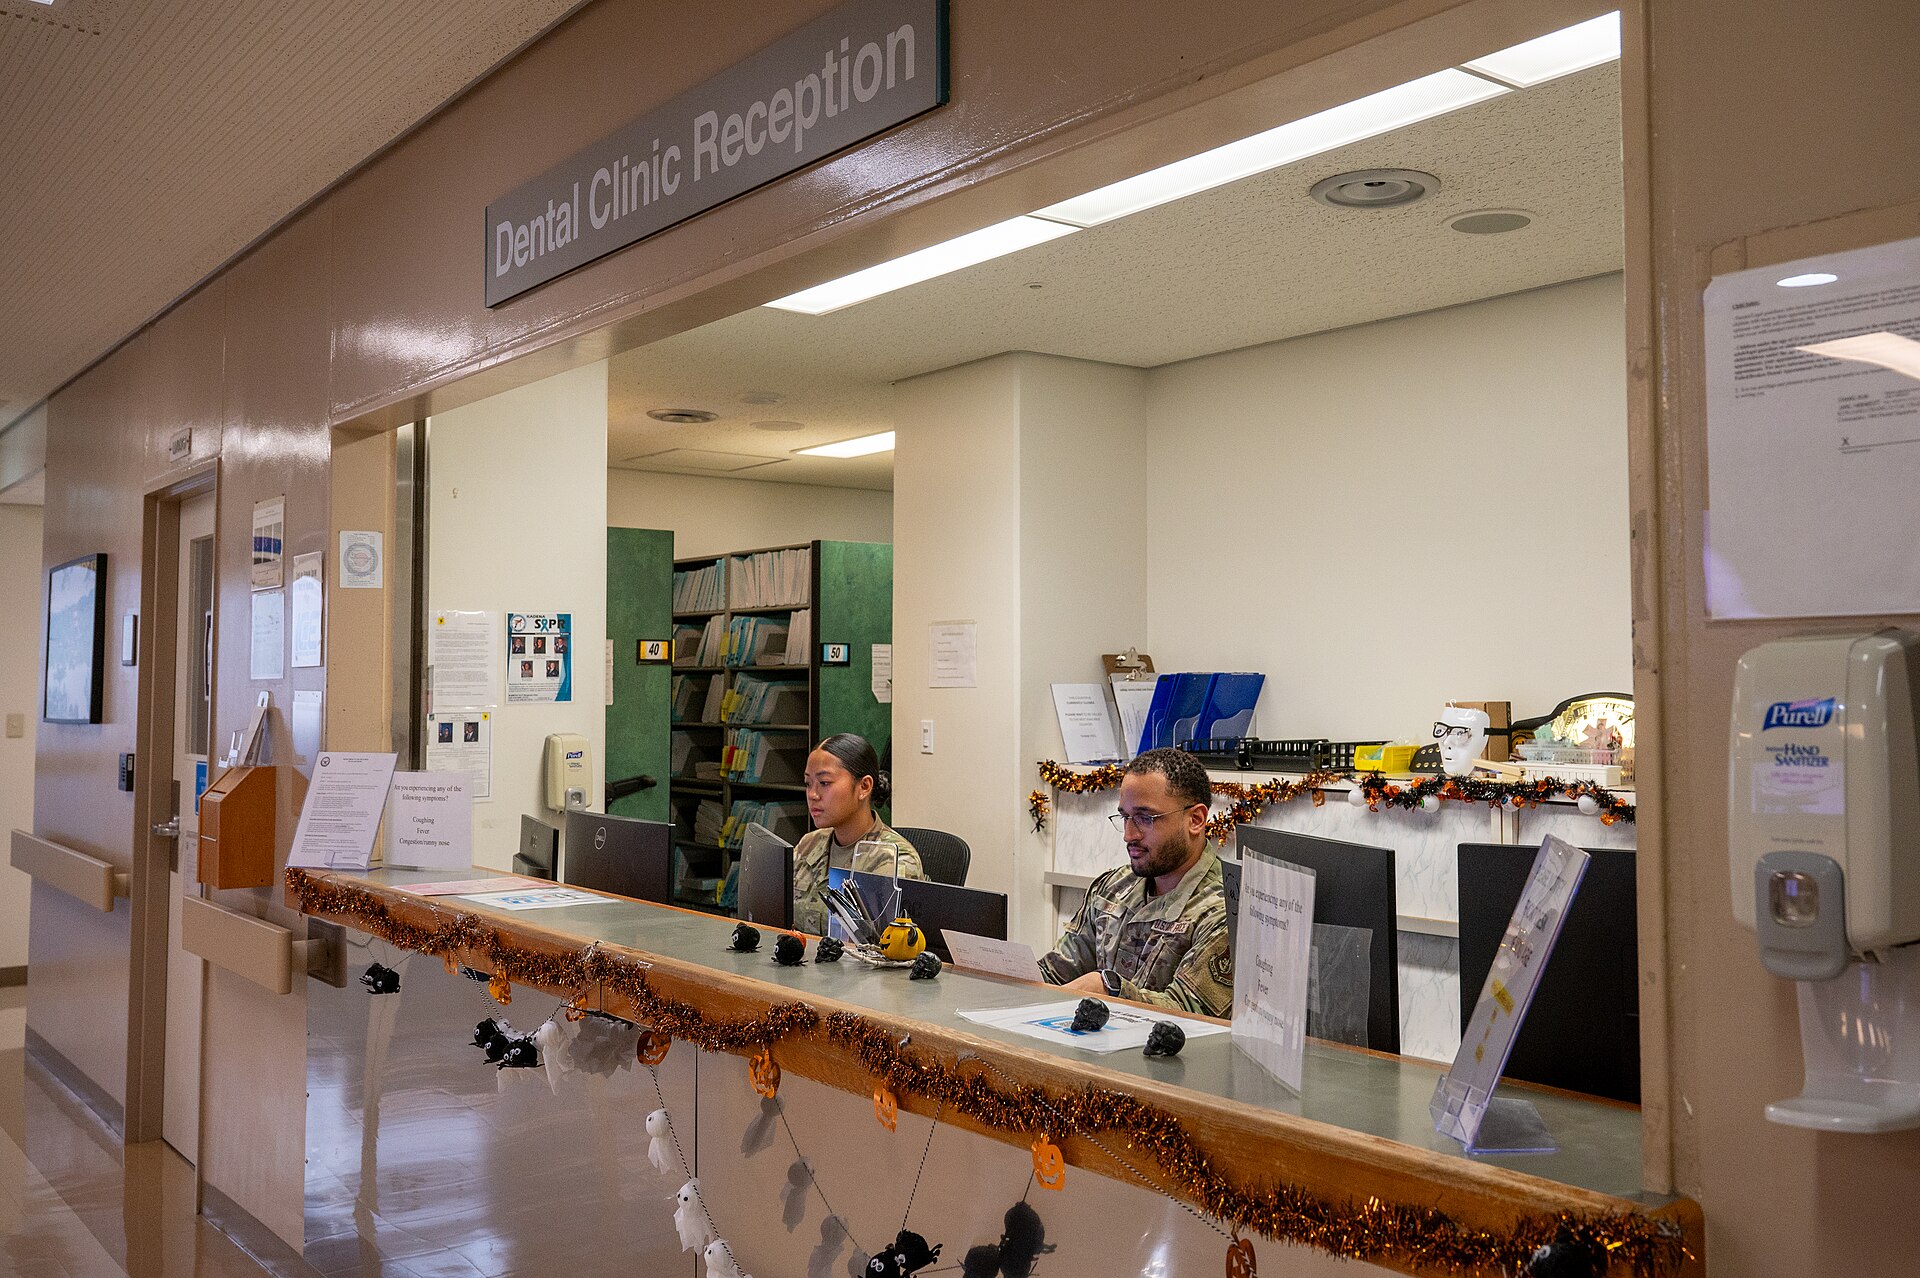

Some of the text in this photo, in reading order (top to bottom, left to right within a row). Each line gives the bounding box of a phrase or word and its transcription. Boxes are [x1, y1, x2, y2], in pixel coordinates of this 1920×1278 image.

[496, 23, 915, 278] Dental Clinic Reception
[649, 643, 660, 656] 40
[831, 647, 841, 658] 50
[1770, 704, 1826, 725] Purell
[1784, 743, 1820, 756] HAND
[1775, 754, 1829, 767] SANITIZER
[409, 785, 436, 793] experiencing
[437, 785, 445, 793] any
[402, 794, 421, 802] following
[413, 816, 435, 824] Coughing
[1279, 898, 1288, 912] any
[1288, 899, 1295, 911] of
[1294, 901, 1303, 913] the
[1255, 954, 1273, 977] Coughing
[1257, 978, 1269, 995] Fever
